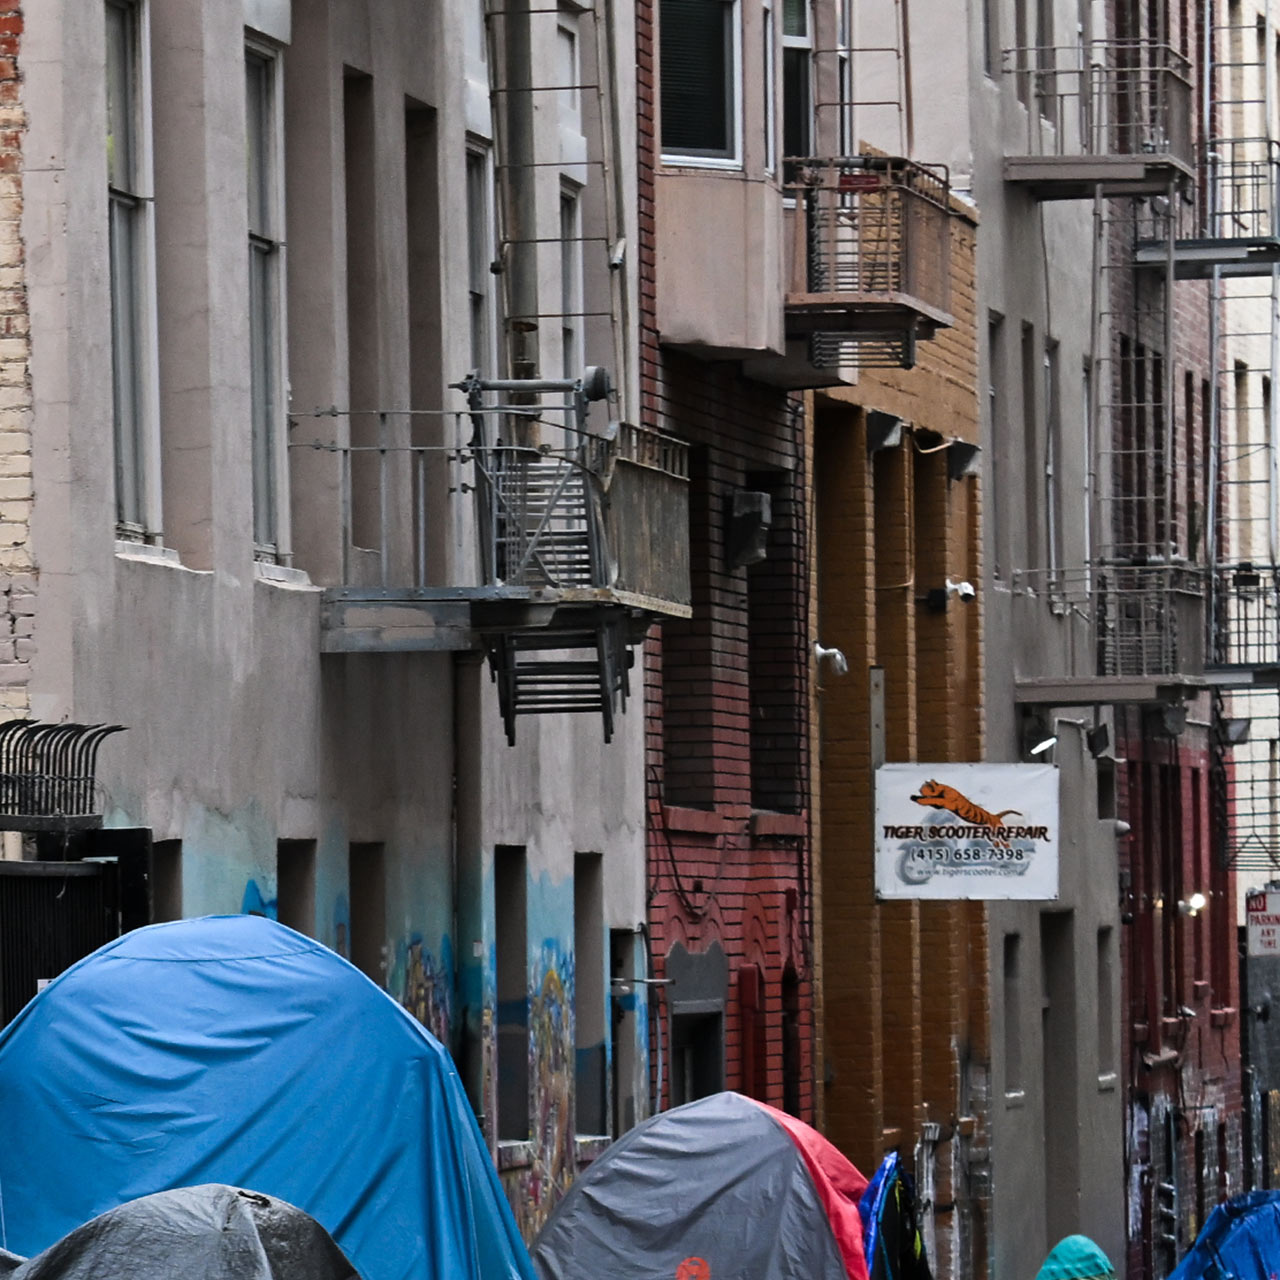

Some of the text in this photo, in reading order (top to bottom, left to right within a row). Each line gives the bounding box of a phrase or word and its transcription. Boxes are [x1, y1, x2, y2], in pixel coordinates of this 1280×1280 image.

[883, 825, 1051, 842] TIGER SCOOTER REPAIR
[911, 848, 1024, 862] (415) 658-7398
[1249, 896, 1265, 910] NO
[1250, 914, 1280, 926] PARKIN
